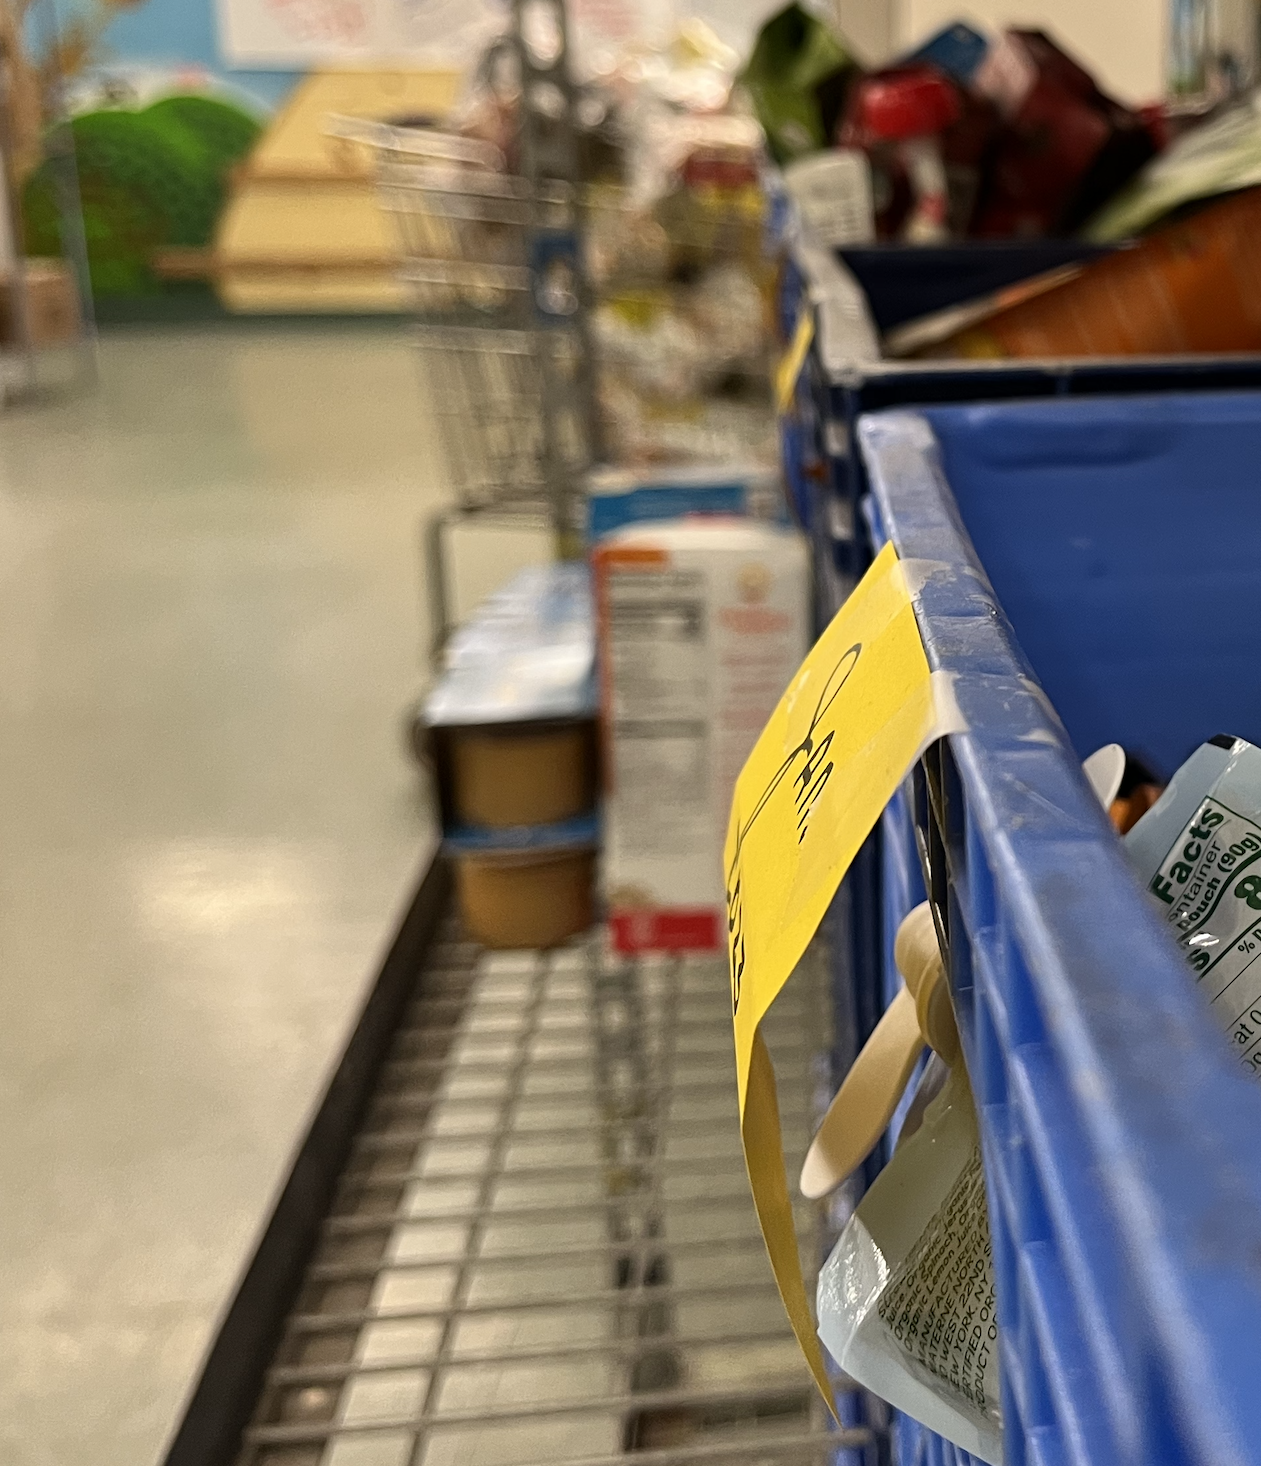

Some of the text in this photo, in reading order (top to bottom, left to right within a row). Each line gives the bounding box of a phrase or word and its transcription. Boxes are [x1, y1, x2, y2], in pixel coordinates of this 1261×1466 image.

[1153, 808, 1225, 905] Facts
[1177, 880, 1220, 931] pouch
[1238, 939, 1255, 954] %
[1232, 1022, 1255, 1045] at
[907, 1236, 941, 1288] Organic
[953, 1234, 985, 1295] NORTH
[974, 1273, 988, 1302] NY
[894, 1284, 921, 1341] Organic
[904, 1295, 928, 1352] Organic
[926, 1250, 954, 1294] Lemon
[916, 1231, 977, 1366] MANUFACTURED
[940, 1307, 960, 1361] WEST
[959, 1259, 984, 1307] 22ND
[962, 1325, 982, 1401] ERTIFIED
